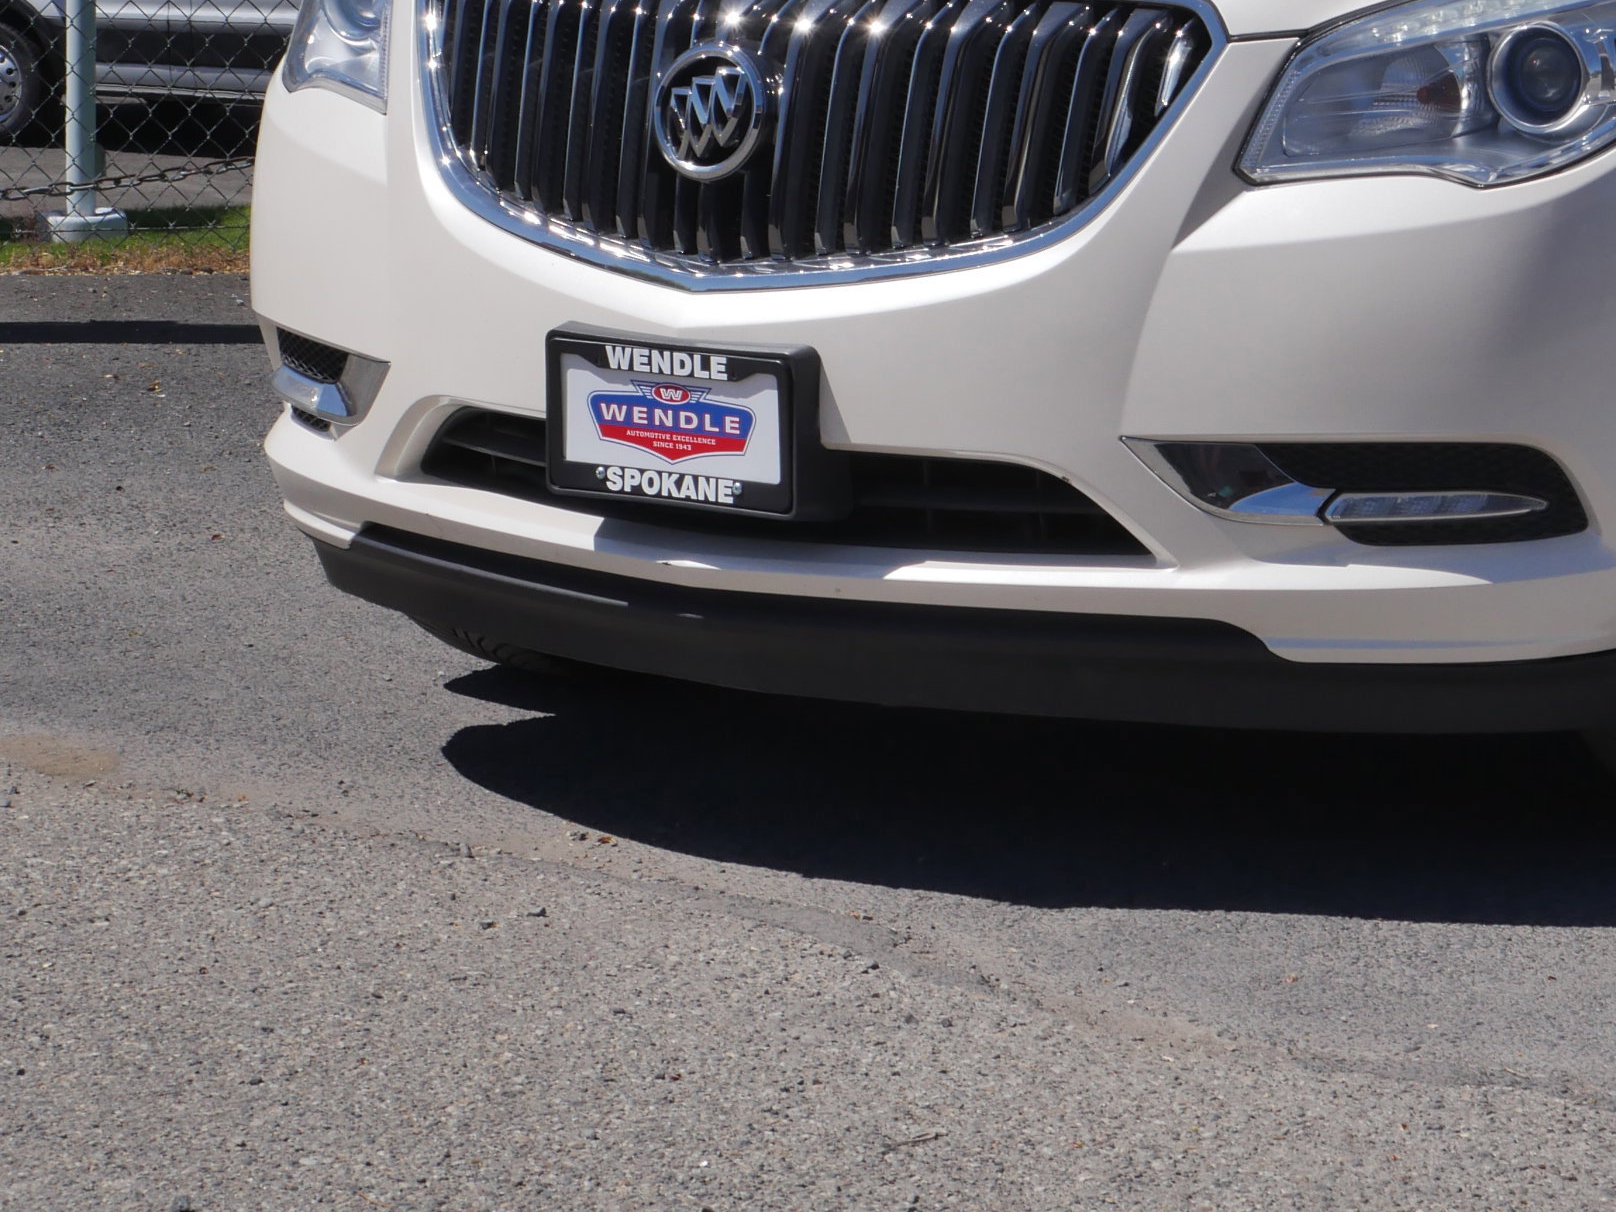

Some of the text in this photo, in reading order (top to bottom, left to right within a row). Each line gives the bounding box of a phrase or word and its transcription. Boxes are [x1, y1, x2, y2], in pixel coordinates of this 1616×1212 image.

[605, 345, 728, 381] WENDLE
[600, 403, 740, 434] WENDLE
[626, 429, 716, 445] AUTOMOTIVE EXCELLENCE
[653, 440, 692, 451] SINCE 1943
[606, 465, 734, 504] SPOKANE
